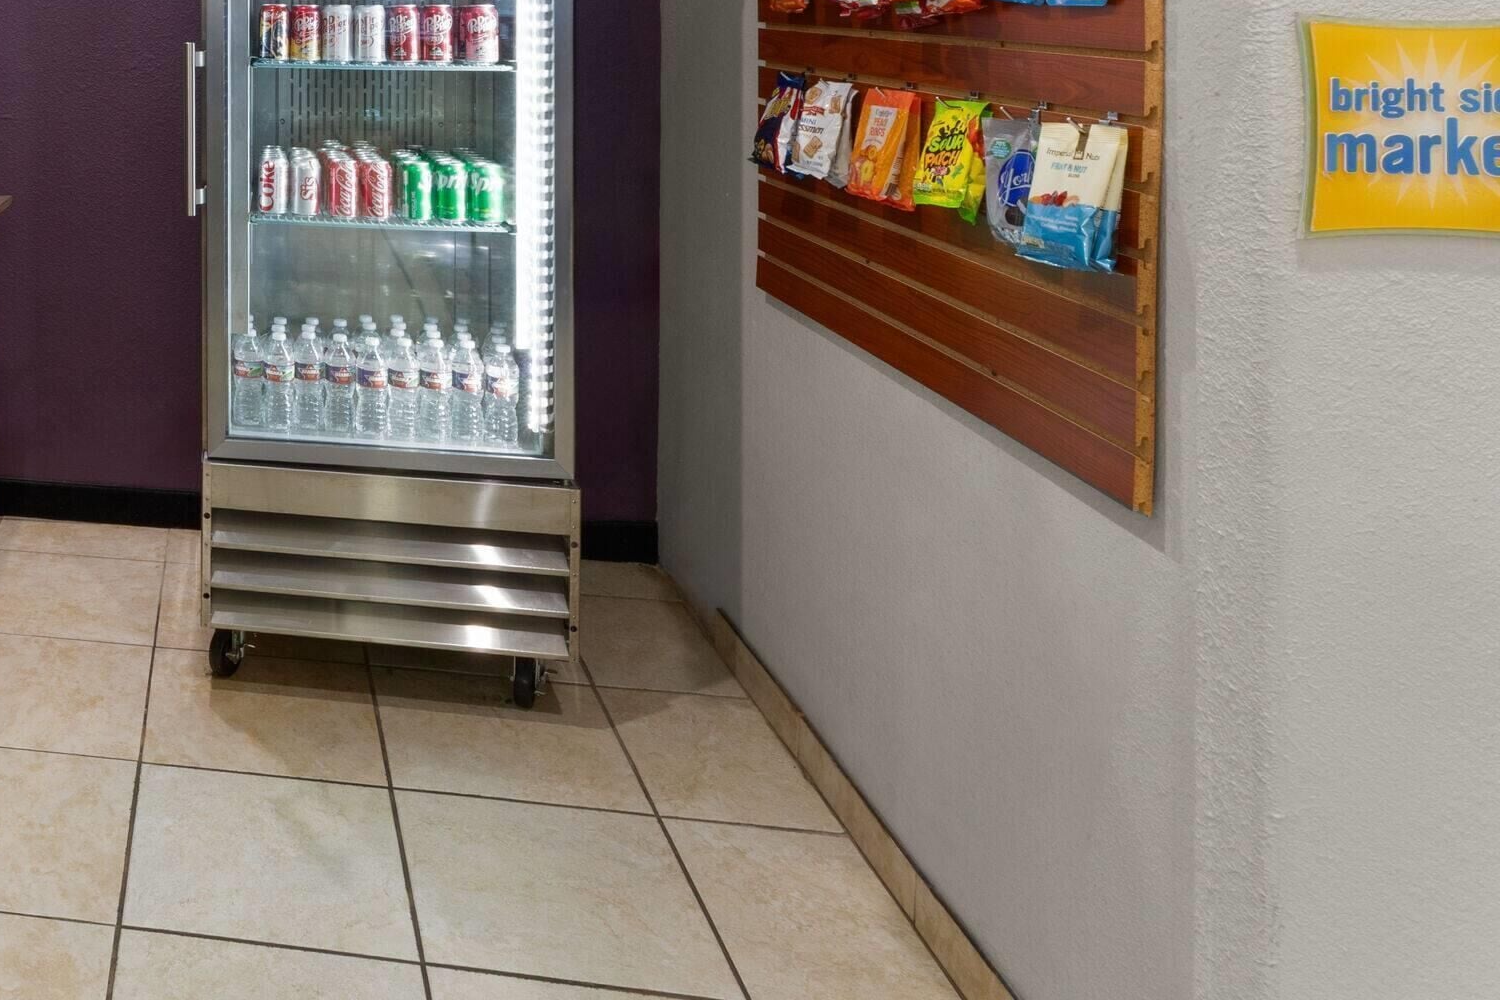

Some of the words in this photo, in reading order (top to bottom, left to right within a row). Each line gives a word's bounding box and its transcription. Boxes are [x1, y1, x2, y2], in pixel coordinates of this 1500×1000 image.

[1330, 77, 1445, 119] bright
[929, 135, 965, 152] SOUR
[925, 151, 960, 168] PATCH
[259, 160, 276, 213] Coke
